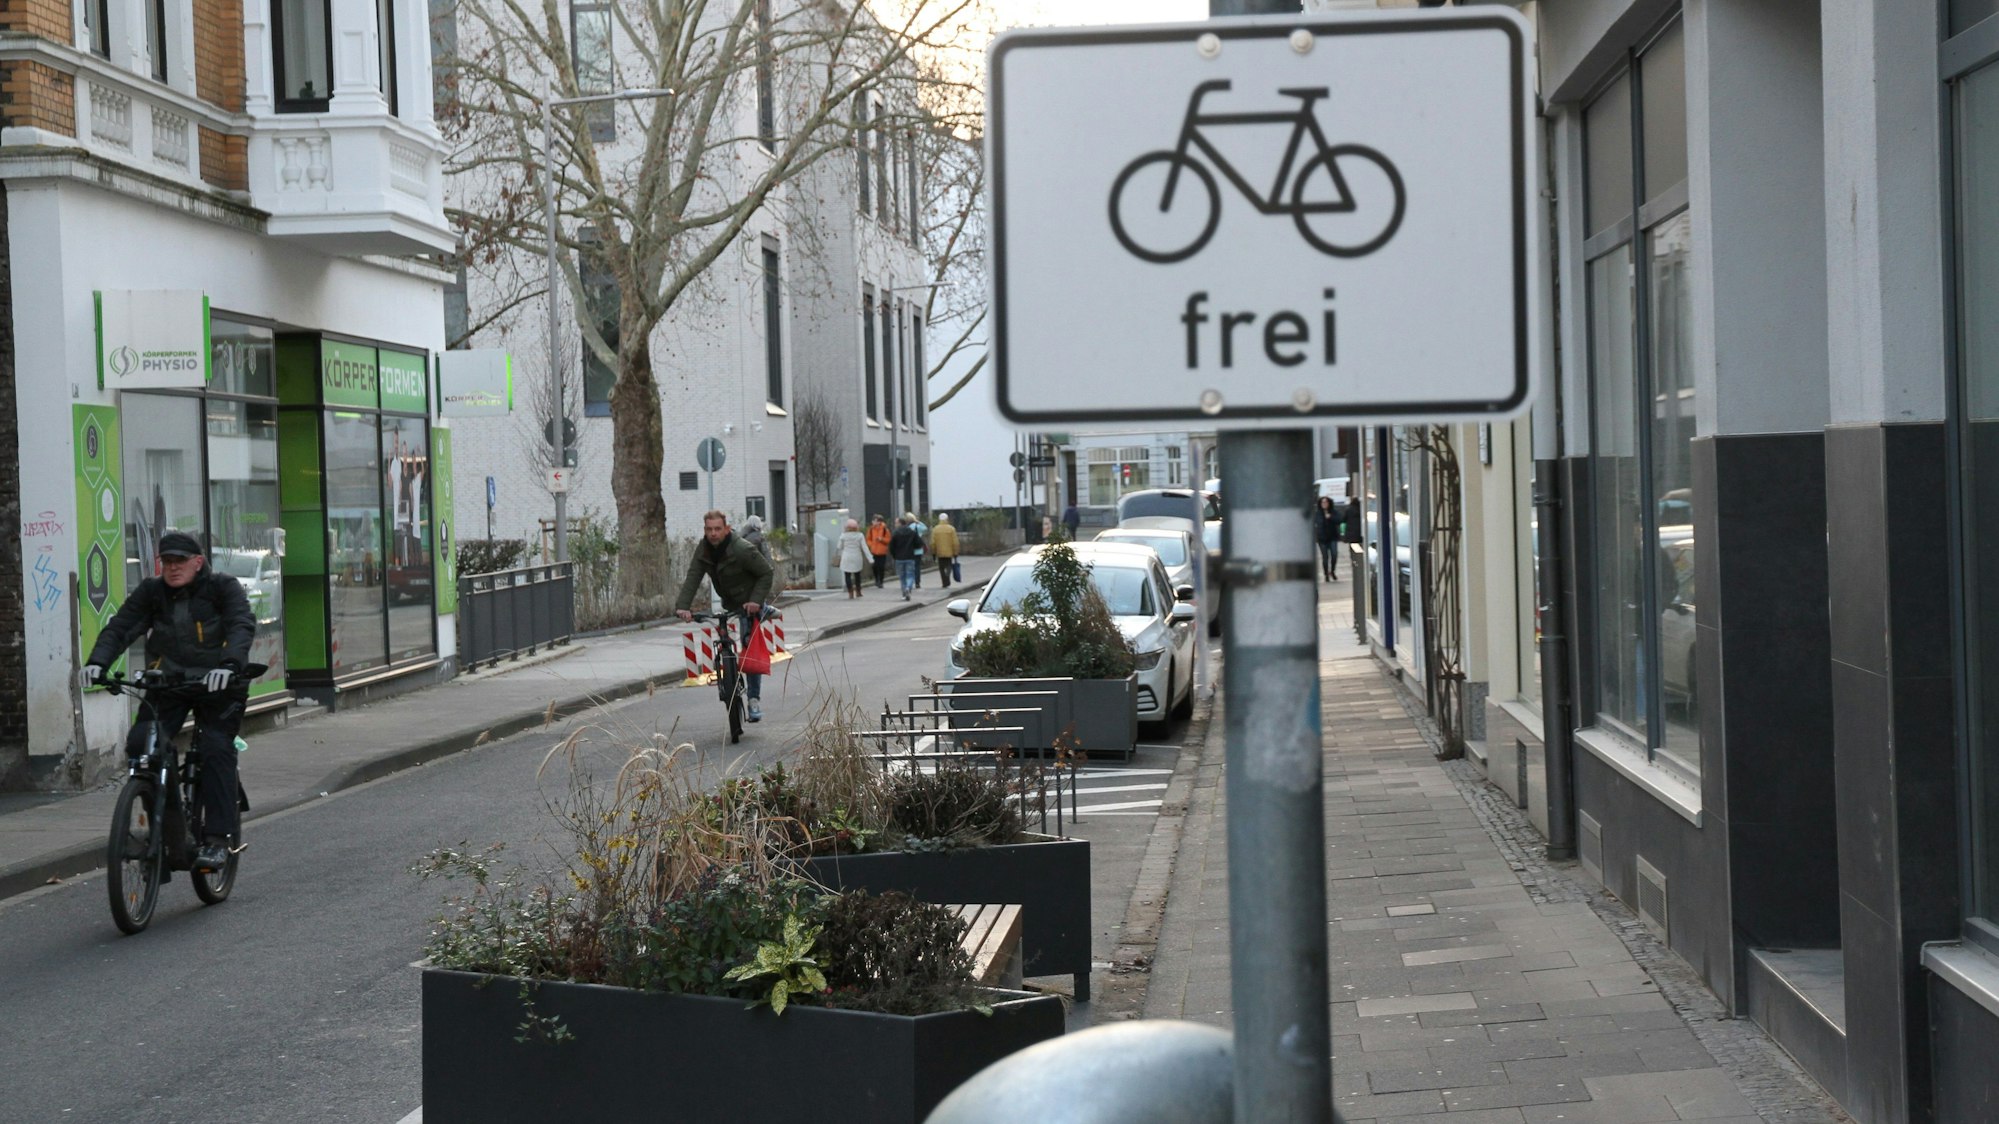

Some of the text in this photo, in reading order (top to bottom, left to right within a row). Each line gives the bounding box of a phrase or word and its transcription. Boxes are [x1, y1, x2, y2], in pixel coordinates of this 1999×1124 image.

[1180, 287, 1336, 369] frei
[142, 359, 198, 371] PHYSIO
[324, 351, 425, 396] KÖRPER FORMEN
